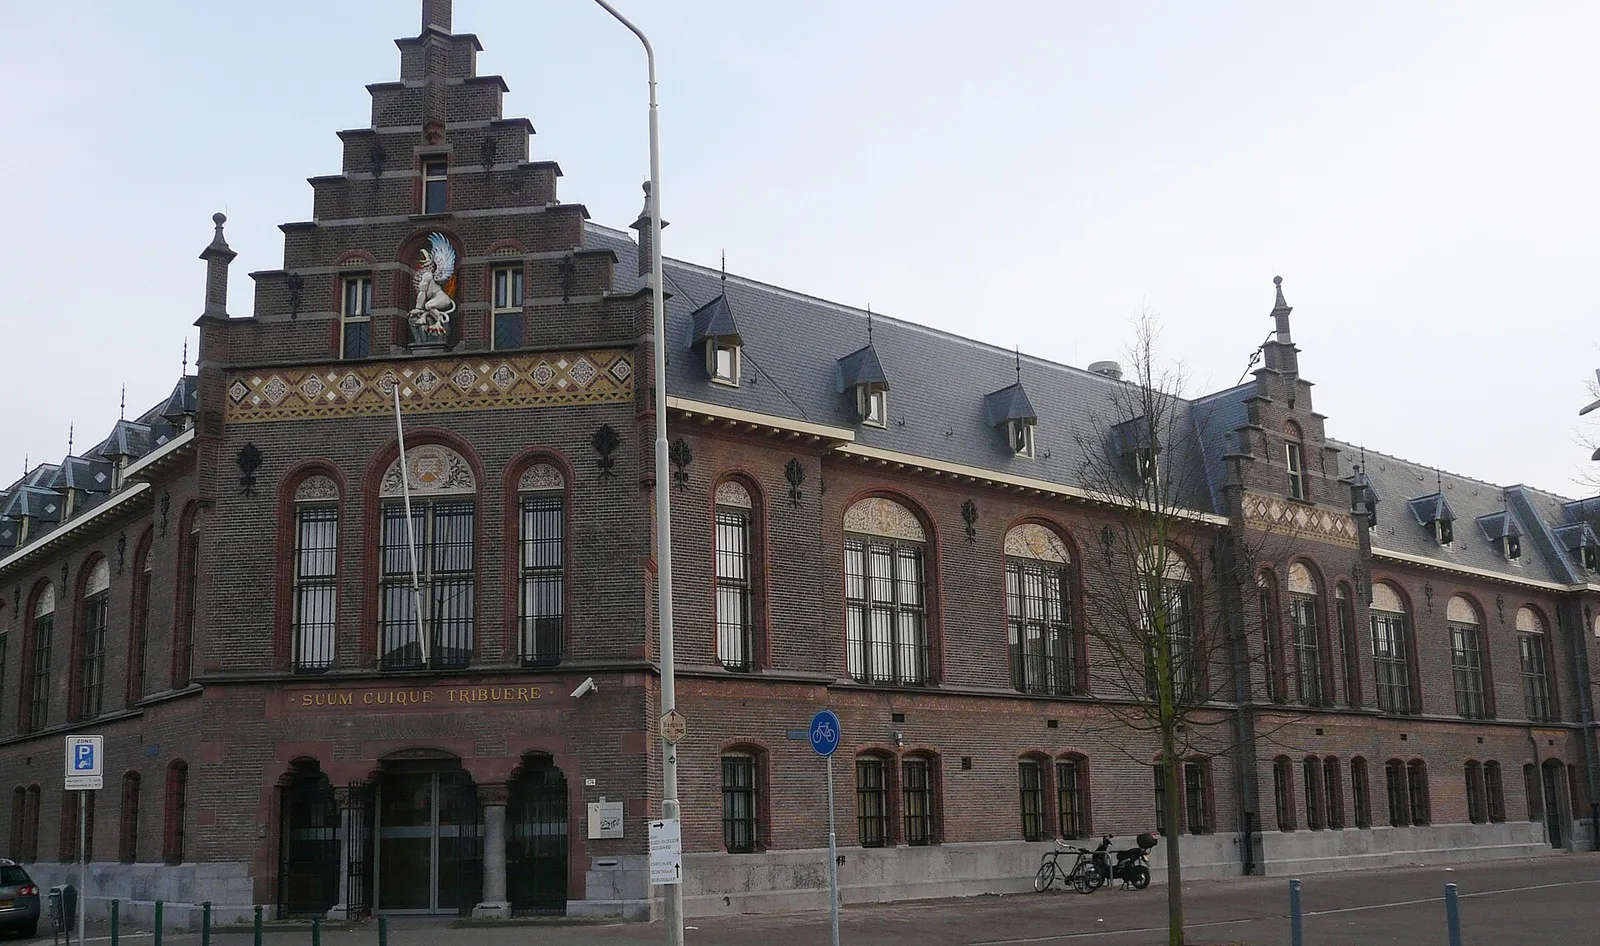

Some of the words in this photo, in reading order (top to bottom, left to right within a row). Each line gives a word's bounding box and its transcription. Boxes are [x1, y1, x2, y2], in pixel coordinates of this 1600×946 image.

[302, 693, 353, 707] SUUM
[363, 690, 434, 706] CUIQUE
[446, 687, 542, 703] TRIBUERE
[79, 746, 90, 760] P
